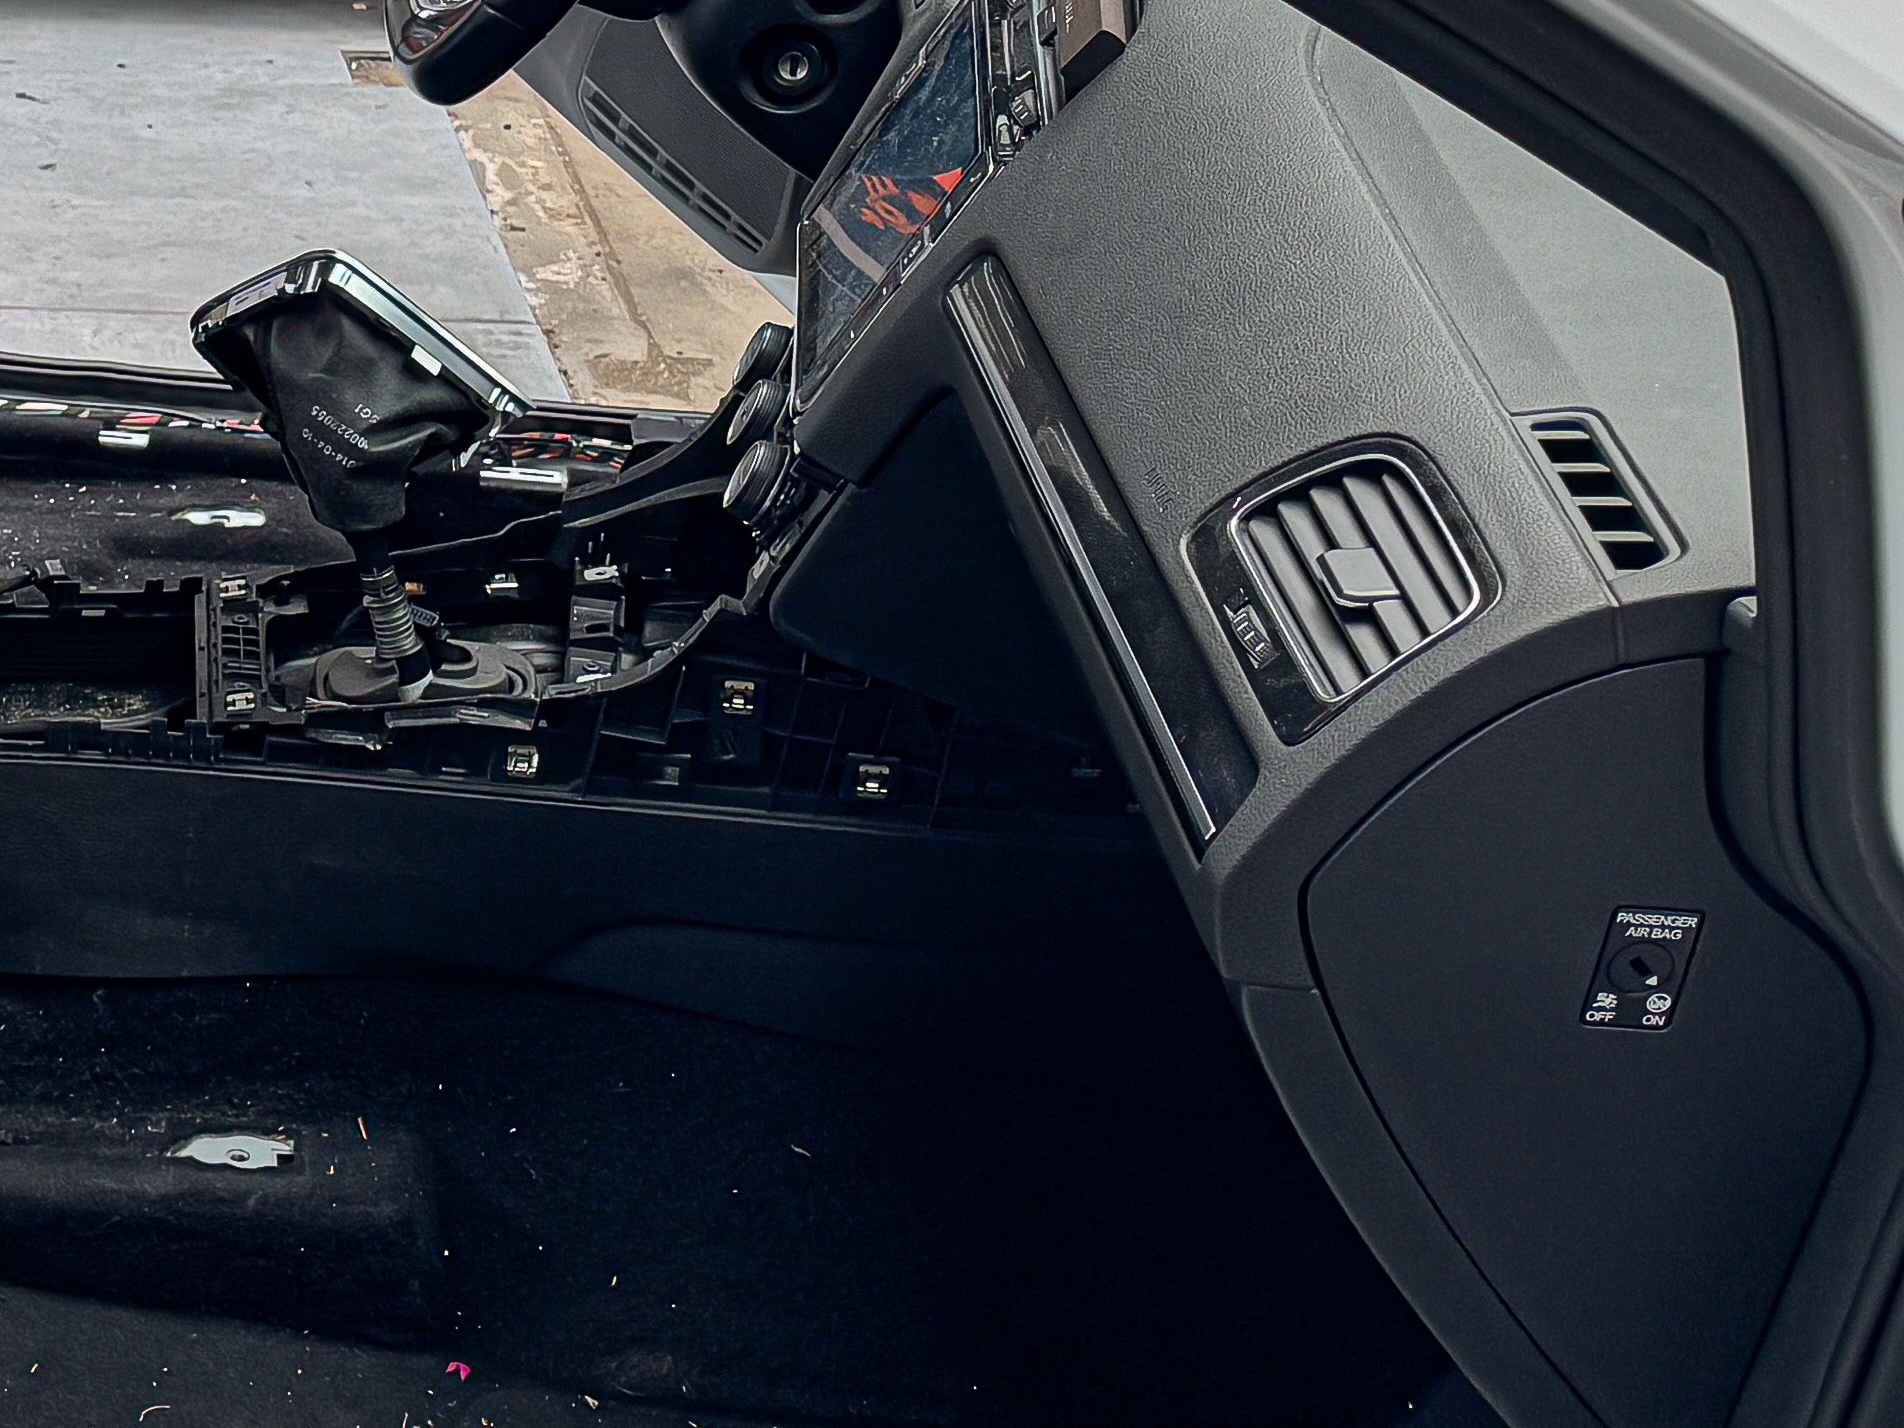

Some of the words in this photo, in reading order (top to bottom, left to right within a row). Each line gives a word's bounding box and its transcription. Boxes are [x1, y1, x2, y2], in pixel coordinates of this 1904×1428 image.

[1616, 912, 1698, 928] PASSENGER
[1624, 926, 1650, 938] AIR
[1650, 928, 1683, 940] BAG
[1585, 1010, 1616, 1022] OFF
[1642, 1014, 1666, 1026] ON
